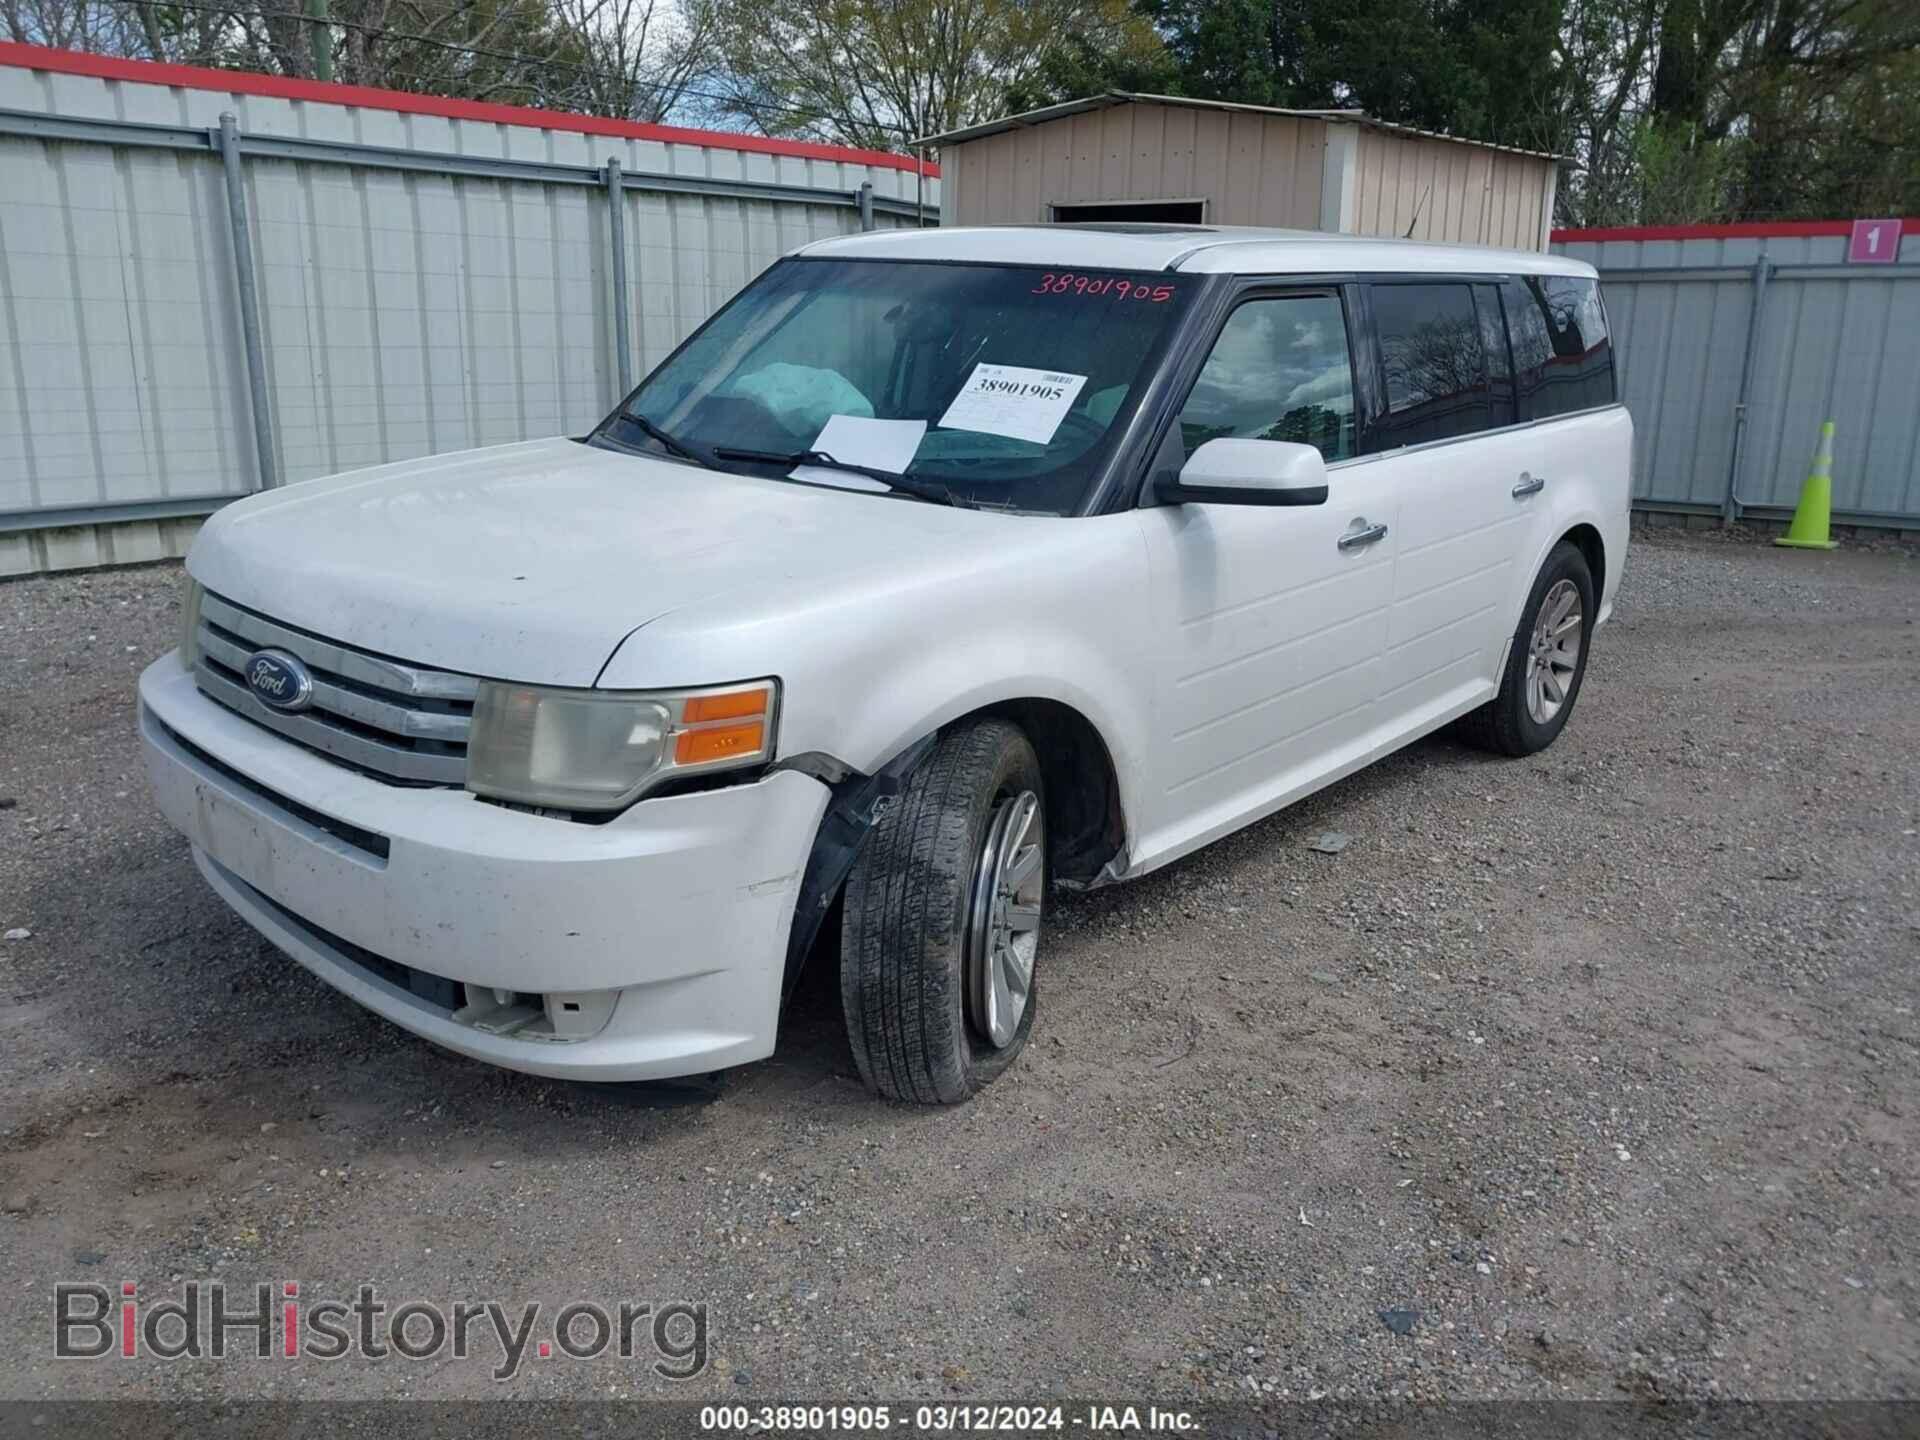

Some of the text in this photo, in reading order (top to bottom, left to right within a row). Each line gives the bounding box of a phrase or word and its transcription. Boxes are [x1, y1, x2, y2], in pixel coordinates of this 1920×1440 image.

[1867, 226, 1880, 253] 1
[1031, 273, 1175, 301] 38901905
[974, 378, 1064, 400] 38901905
[251, 659, 287, 695] Ford
